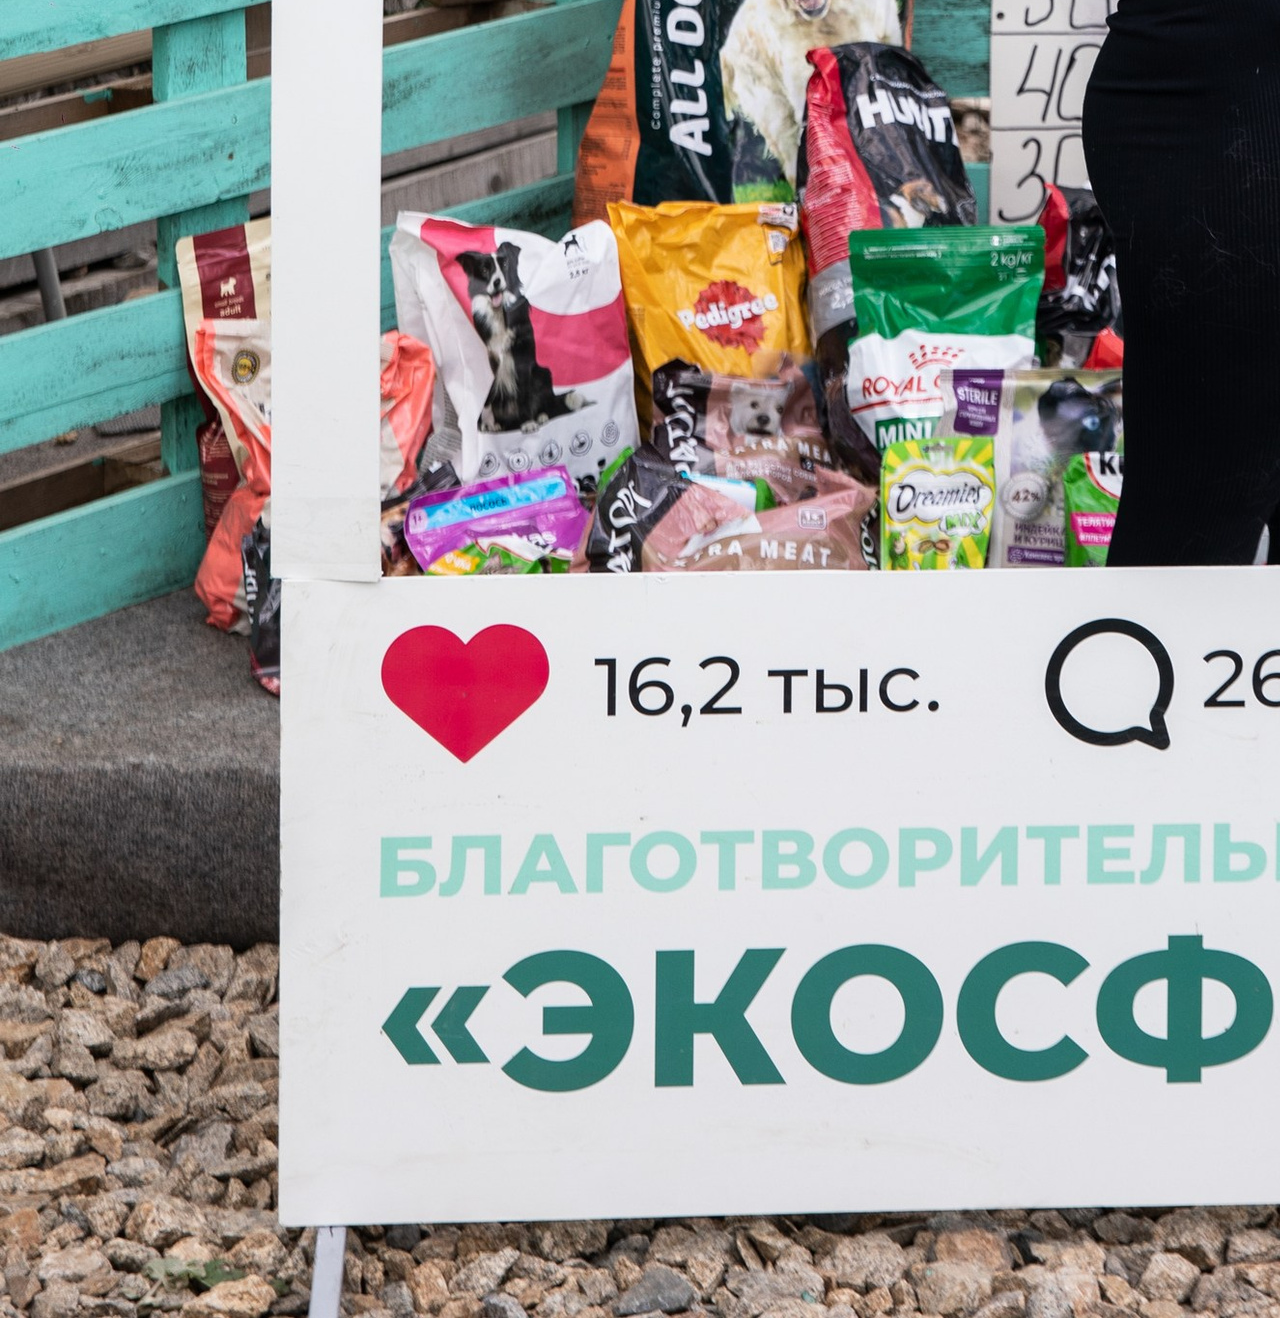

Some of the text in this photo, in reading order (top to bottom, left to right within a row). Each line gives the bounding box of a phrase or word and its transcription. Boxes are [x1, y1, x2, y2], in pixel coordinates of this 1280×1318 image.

[669, 58, 713, 157] ALL
[990, 250, 999, 267] 2
[220, 305, 242, 318] adult
[677, 292, 779, 333] Pedigree
[862, 374, 927, 400] ROYAL
[956, 385, 998, 406] STERILE
[878, 420, 933, 449] MINI
[895, 482, 984, 514] Dreamies
[945, 512, 982, 531] MIX
[759, 538, 832, 568] MEAT
[594, 656, 939, 727] 16,2 тыс.
